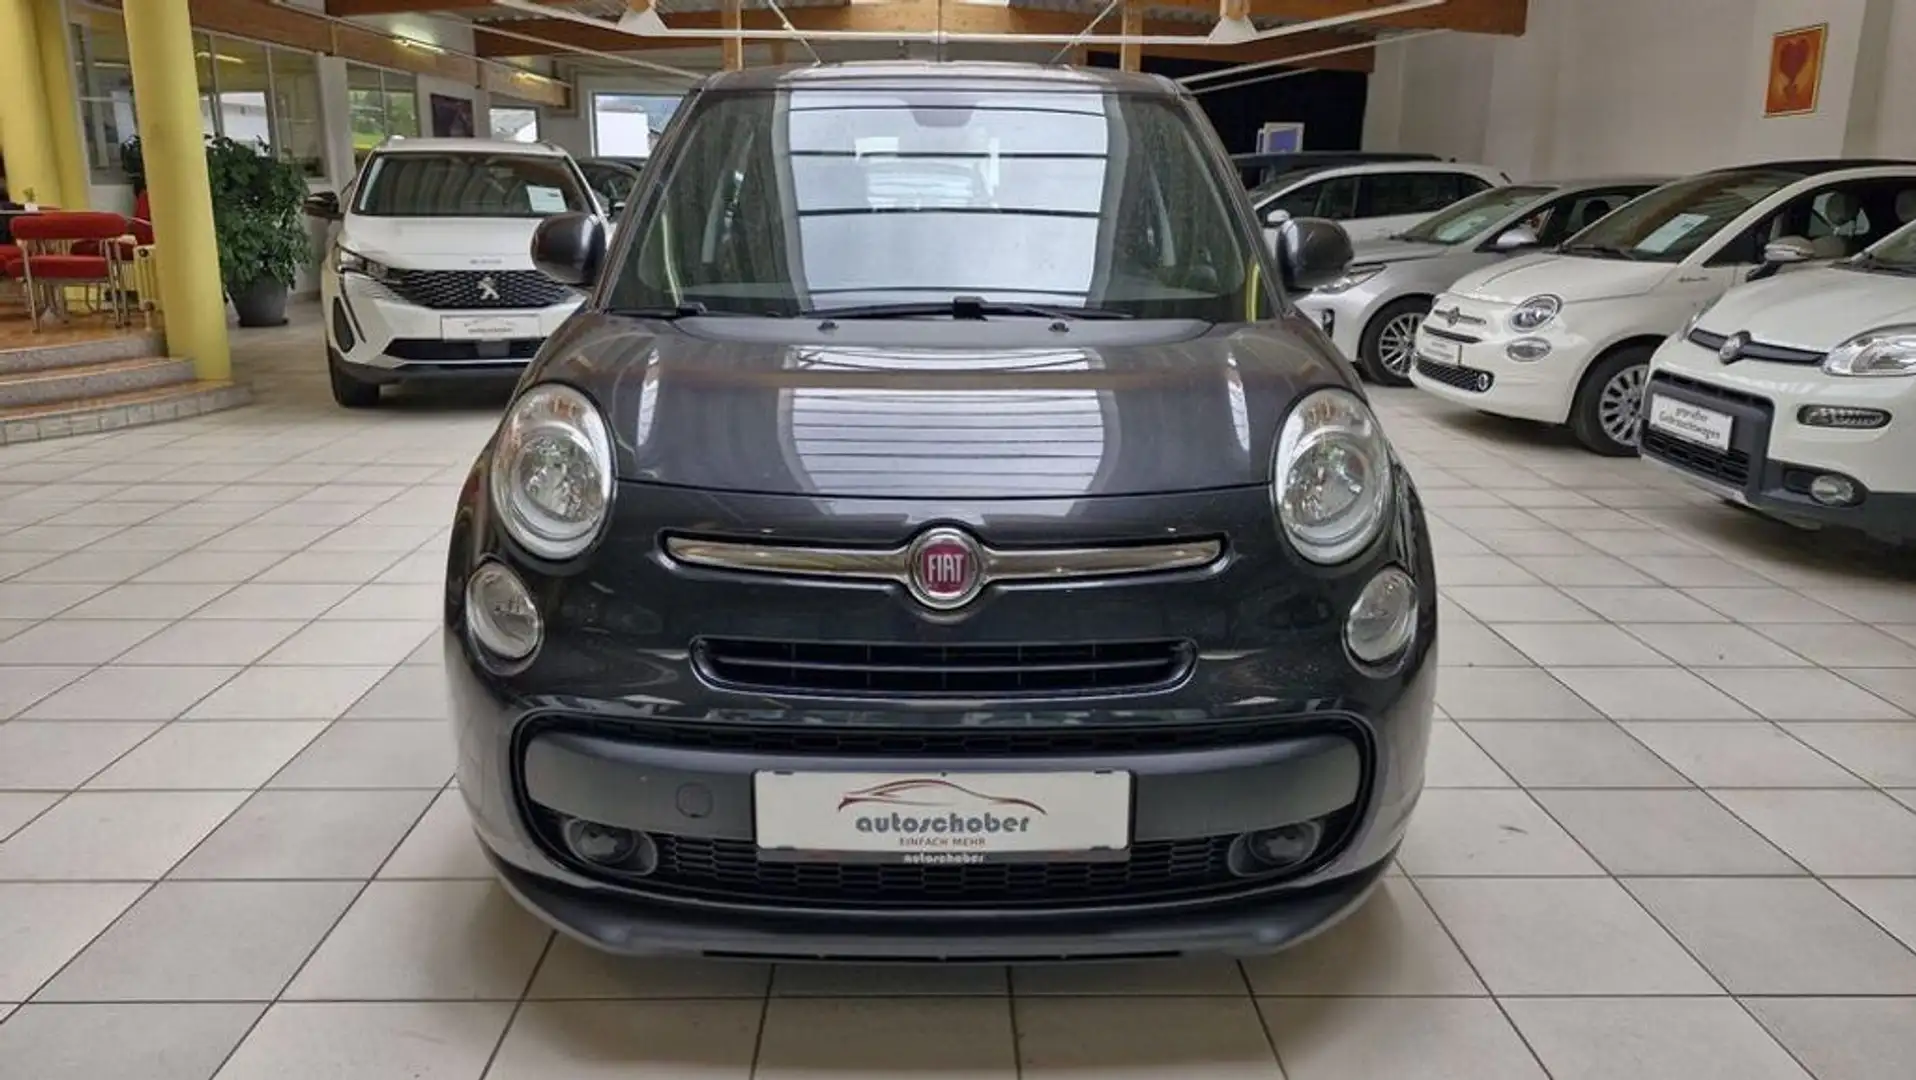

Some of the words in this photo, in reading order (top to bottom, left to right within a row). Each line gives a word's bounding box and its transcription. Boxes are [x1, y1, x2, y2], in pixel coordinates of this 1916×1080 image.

[927, 553, 964, 583] FIAT
[855, 812, 1030, 833] autoschober
[900, 837, 949, 847] EINFACH
[953, 837, 986, 847] MEHR
